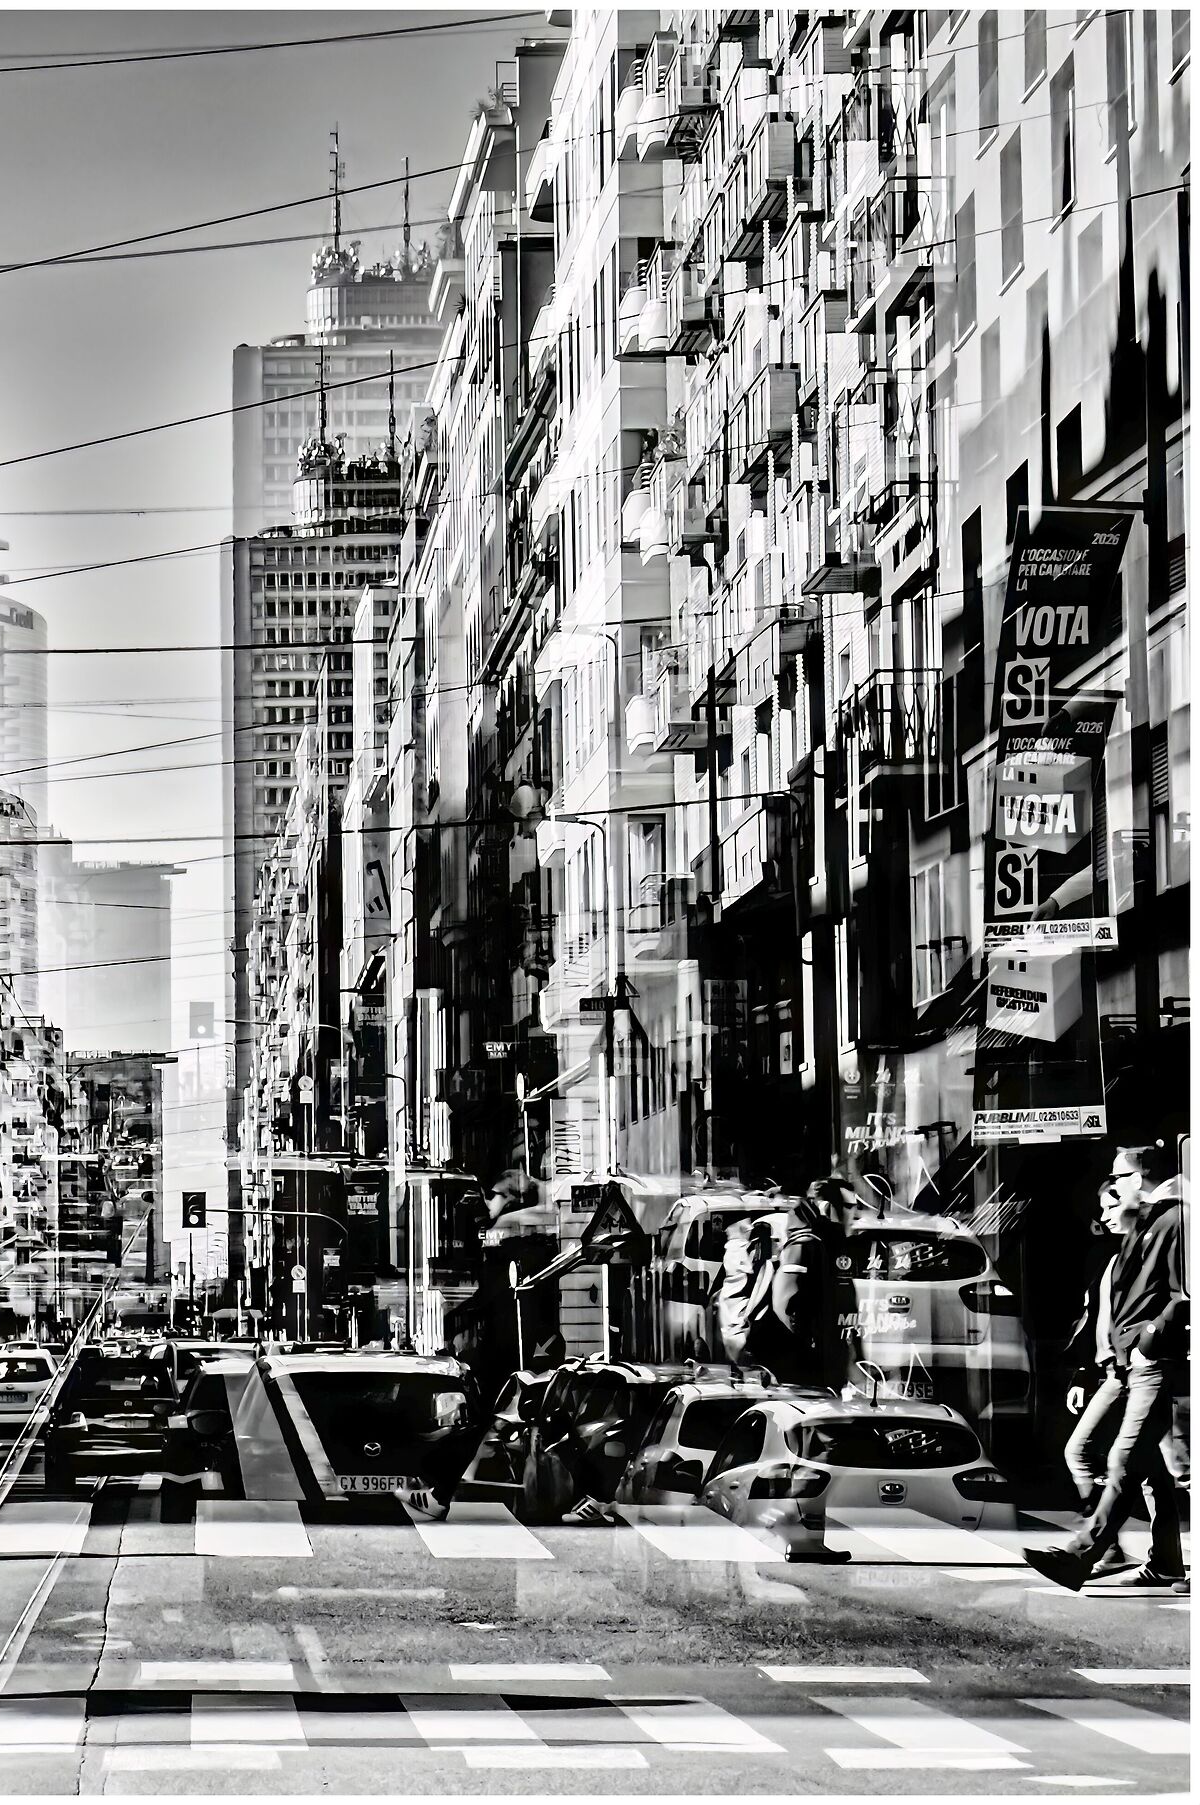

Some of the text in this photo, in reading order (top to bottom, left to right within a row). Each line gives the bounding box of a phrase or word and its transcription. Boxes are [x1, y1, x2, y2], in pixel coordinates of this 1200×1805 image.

[1091, 532, 1121, 545] 2026
[1020, 548, 1090, 562] L'OCCASIONE
[1018, 563, 1093, 577] PER CAMBIARE
[1016, 578, 1028, 592] LA
[1015, 605, 1089, 646] VOTA
[1075, 721, 1104, 734] 2026
[1005, 737, 1074, 751] L'OCCASIONE
[1002, 766, 1015, 781] LA
[1003, 793, 1077, 836] VOTA
[984, 923, 1050, 937] PUBBLIL
[485, 1041, 512, 1052] EMY
[974, 1111, 1040, 1124] PUBBLIMIL
[554, 1120, 581, 1175] PIZZIUM
[340, 1476, 404, 1491] GX 996FR
